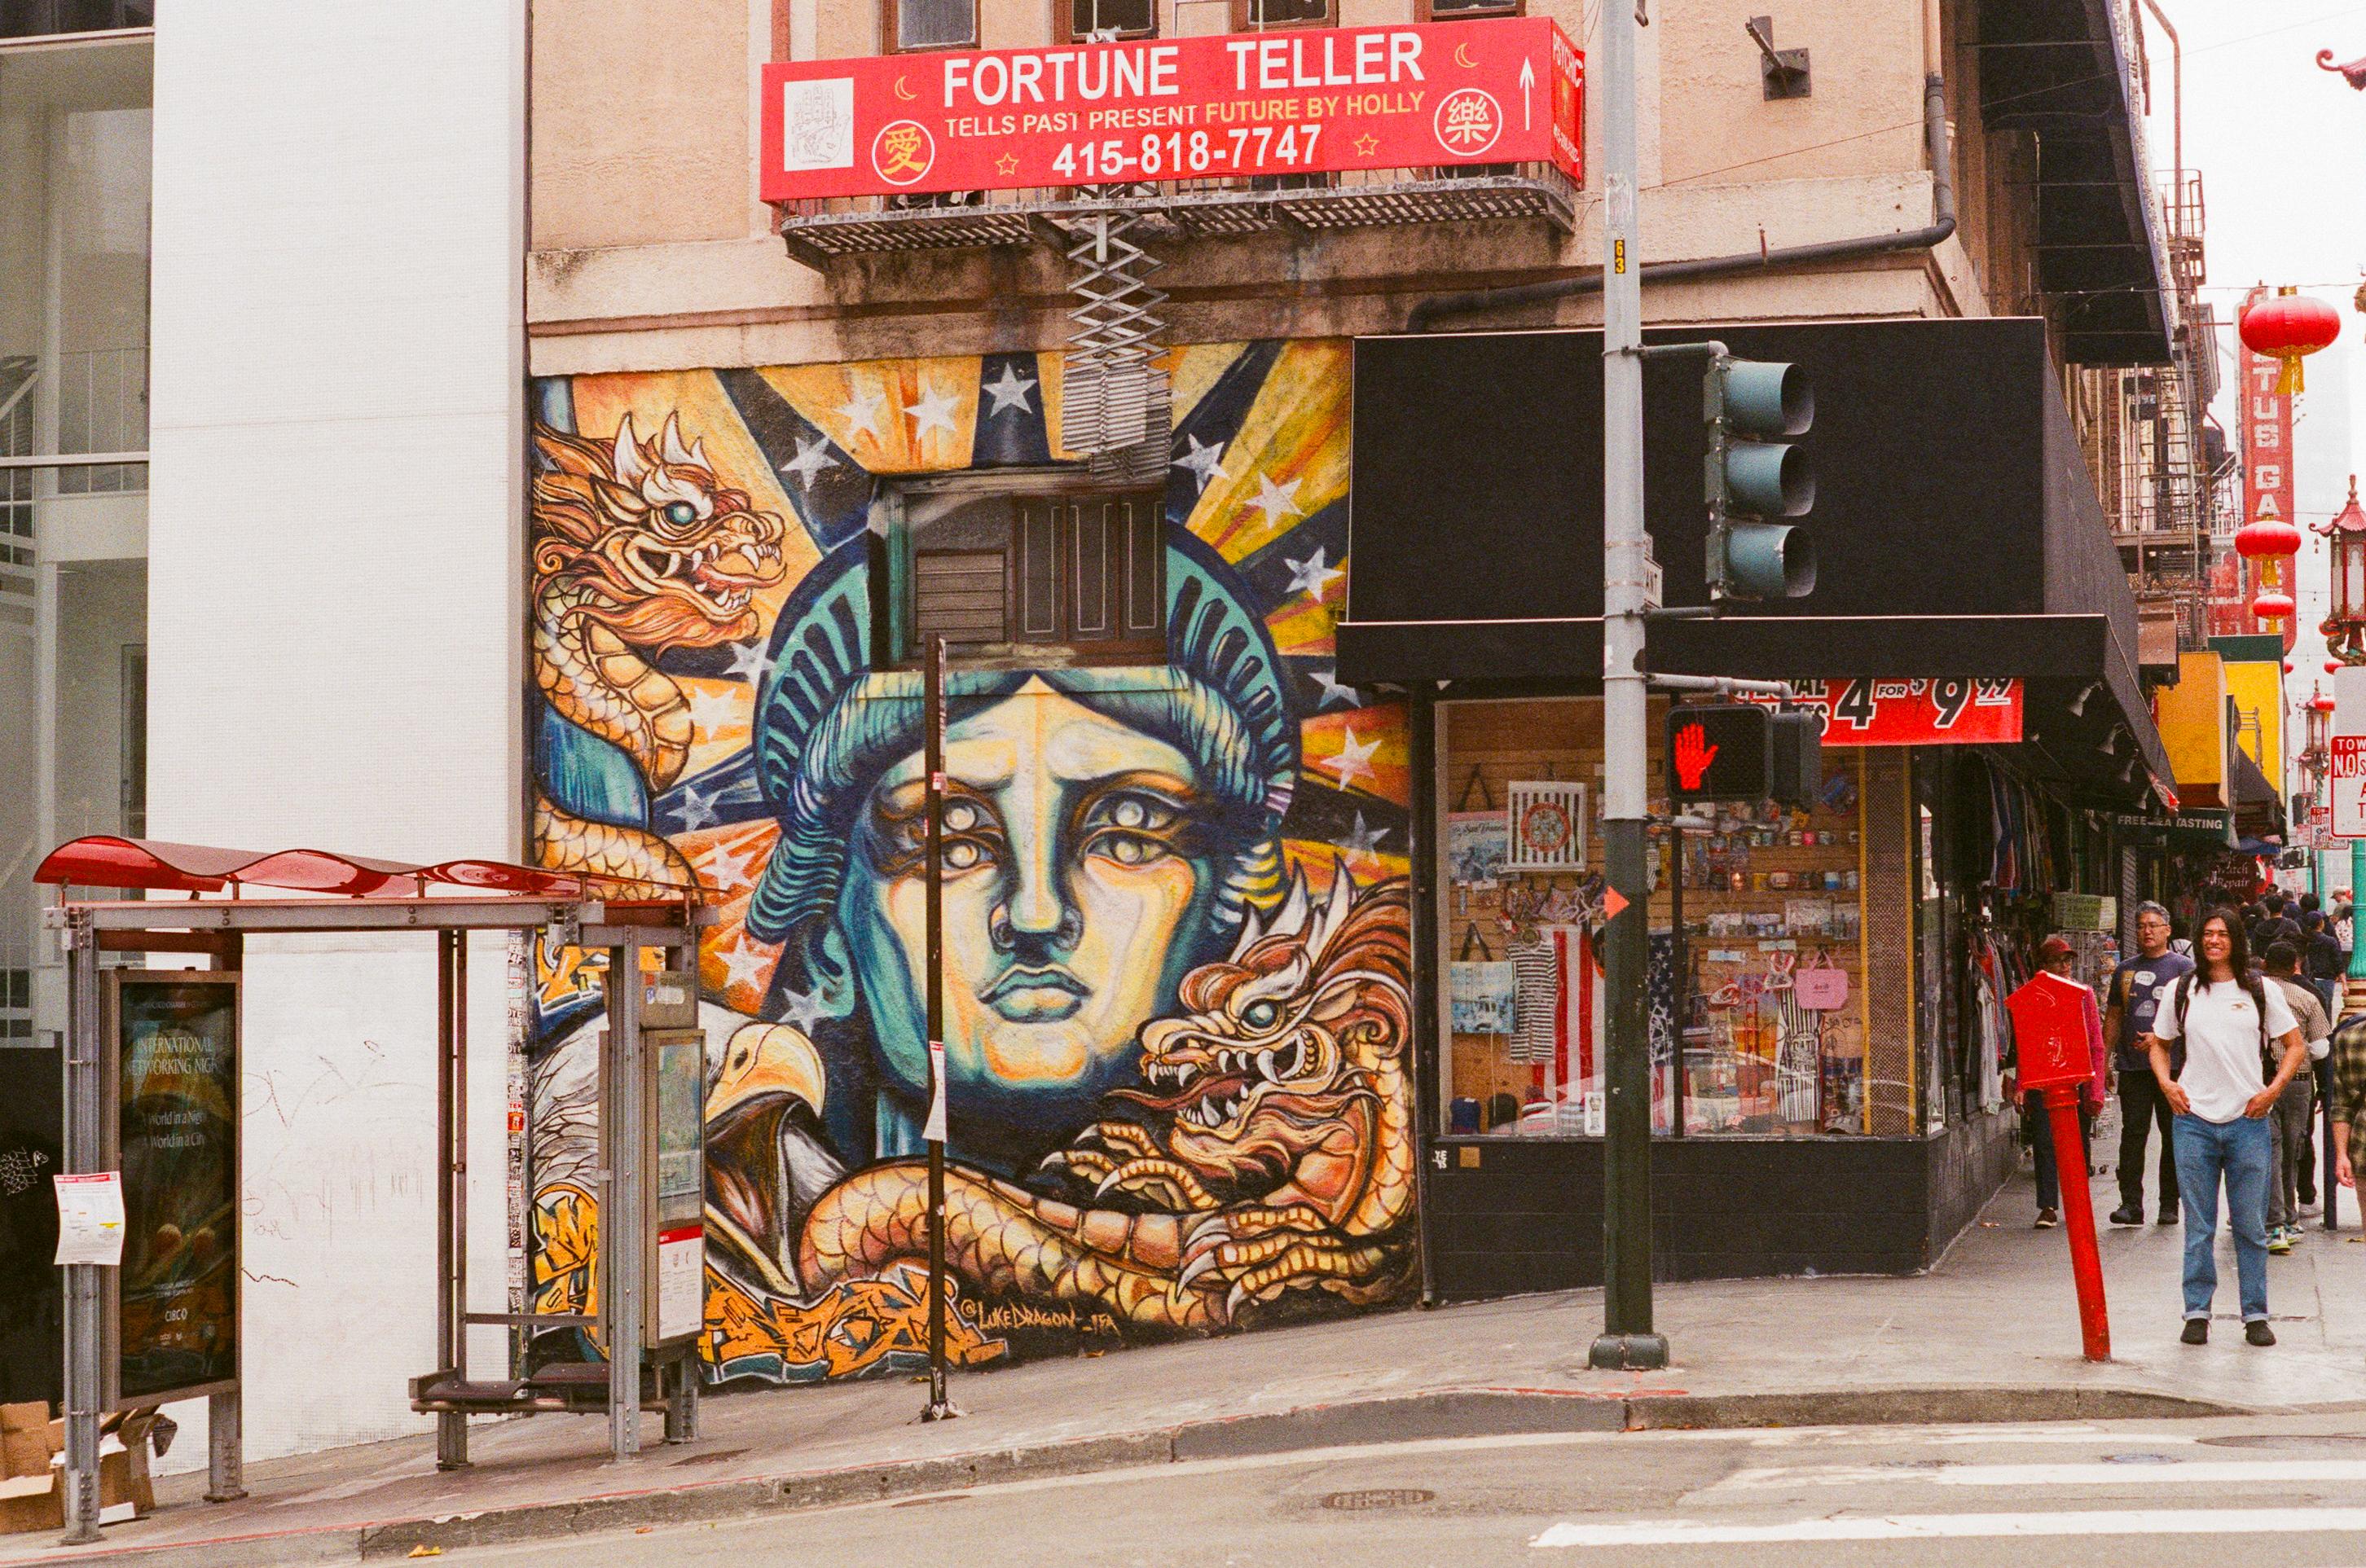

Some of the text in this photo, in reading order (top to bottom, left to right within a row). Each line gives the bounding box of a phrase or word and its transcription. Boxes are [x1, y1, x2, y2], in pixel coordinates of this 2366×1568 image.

[944, 32, 1425, 108] FORTUNE TELLER
[945, 90, 1425, 138] TELLS PAST PRESENT FUTURE BY HOLLY
[1445, 96, 1492, 145] 樂
[885, 126, 926, 175] 愛
[1052, 125, 1322, 178] 415-818-7747
[1616, 240, 1625, 274] 63
[2253, 354, 2280, 447] TUS
[1834, 679, 1876, 730] 4
[1876, 685, 1908, 699] FOR
[2334, 754, 2356, 776] NO
[2118, 815, 2147, 826] FREE
